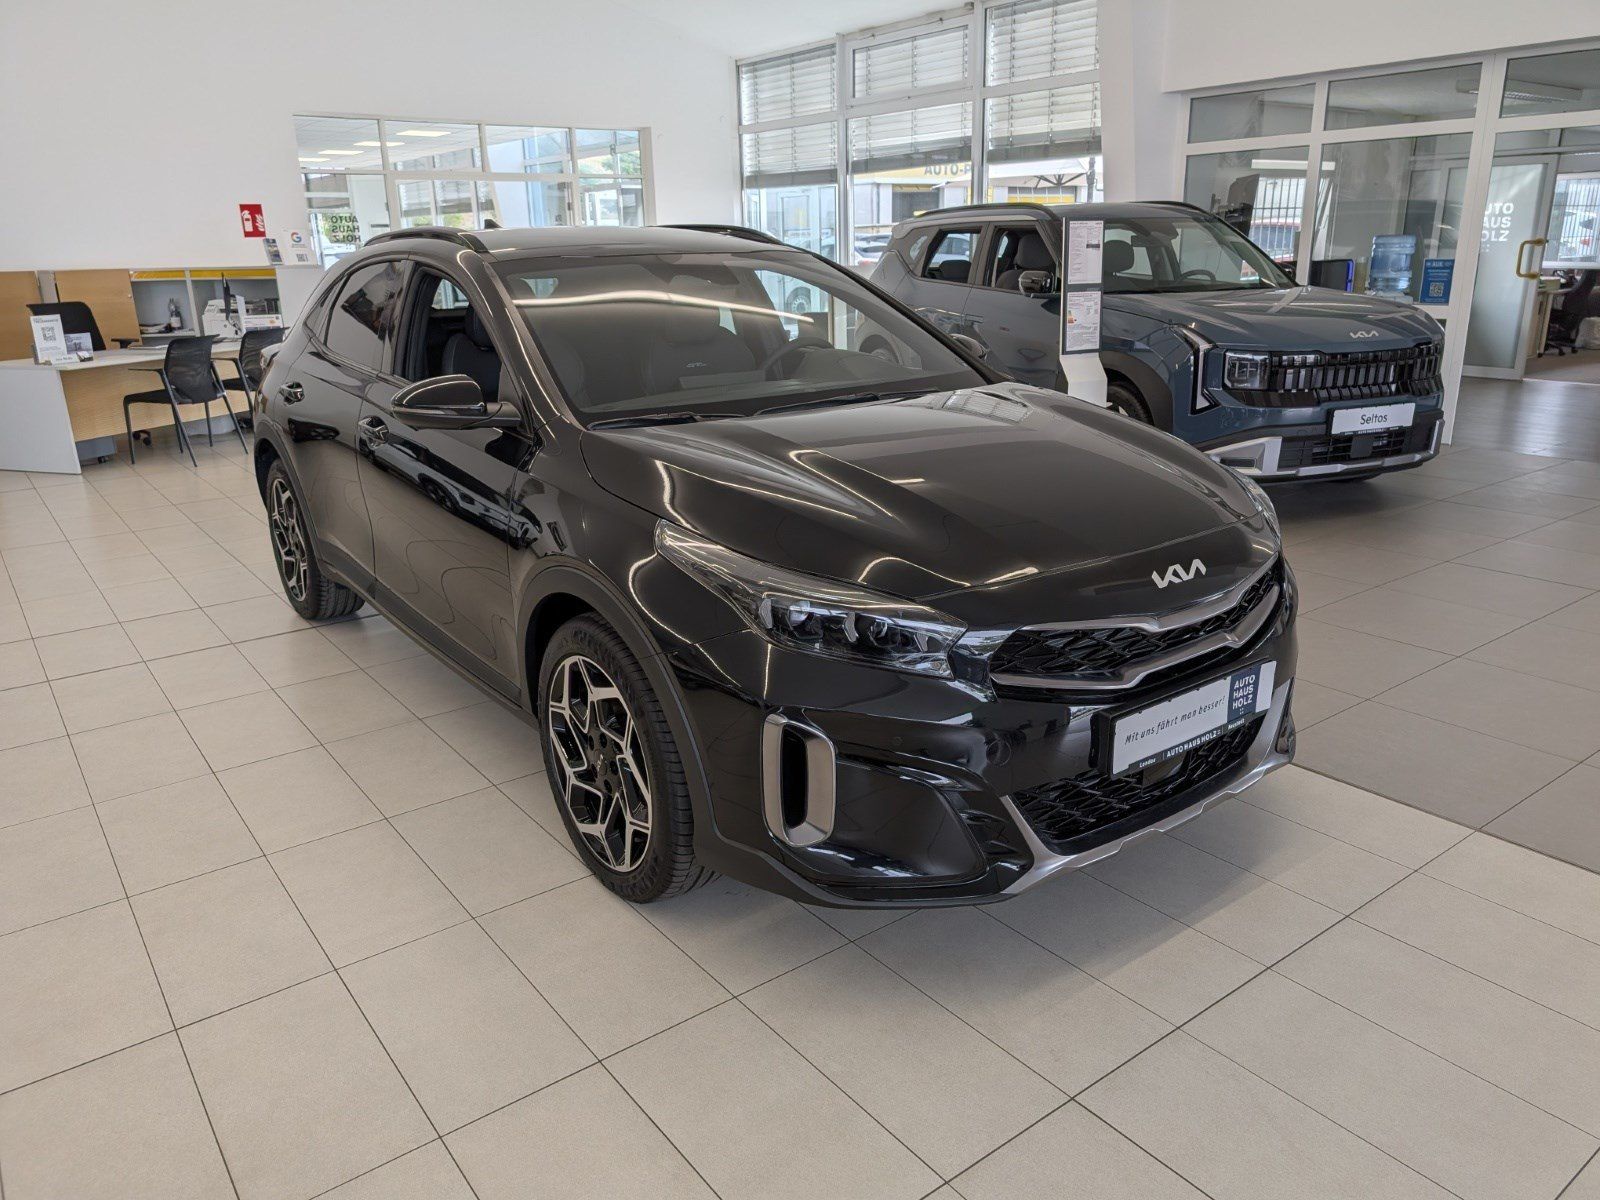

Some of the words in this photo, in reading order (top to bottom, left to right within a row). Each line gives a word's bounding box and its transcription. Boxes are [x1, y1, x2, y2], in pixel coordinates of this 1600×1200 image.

[1484, 202, 1514, 215] UTO
[1483, 216, 1512, 229] AUS
[1481, 230, 1510, 242] OLZ
[1359, 413, 1388, 425] Seltos
[1151, 558, 1207, 589] KIA
[1233, 674, 1256, 690] AUTO
[1233, 684, 1254, 699] HAUS
[1232, 694, 1253, 710] HOLZ
[1124, 731, 1139, 745] Mit
[1140, 726, 1155, 738] uns
[1155, 716, 1178, 735] fährt
[1180, 709, 1197, 722] man
[1166, 745, 1183, 758] AUTO
[1184, 738, 1200, 750] HAUS
[1201, 729, 1217, 742] HOLZ
